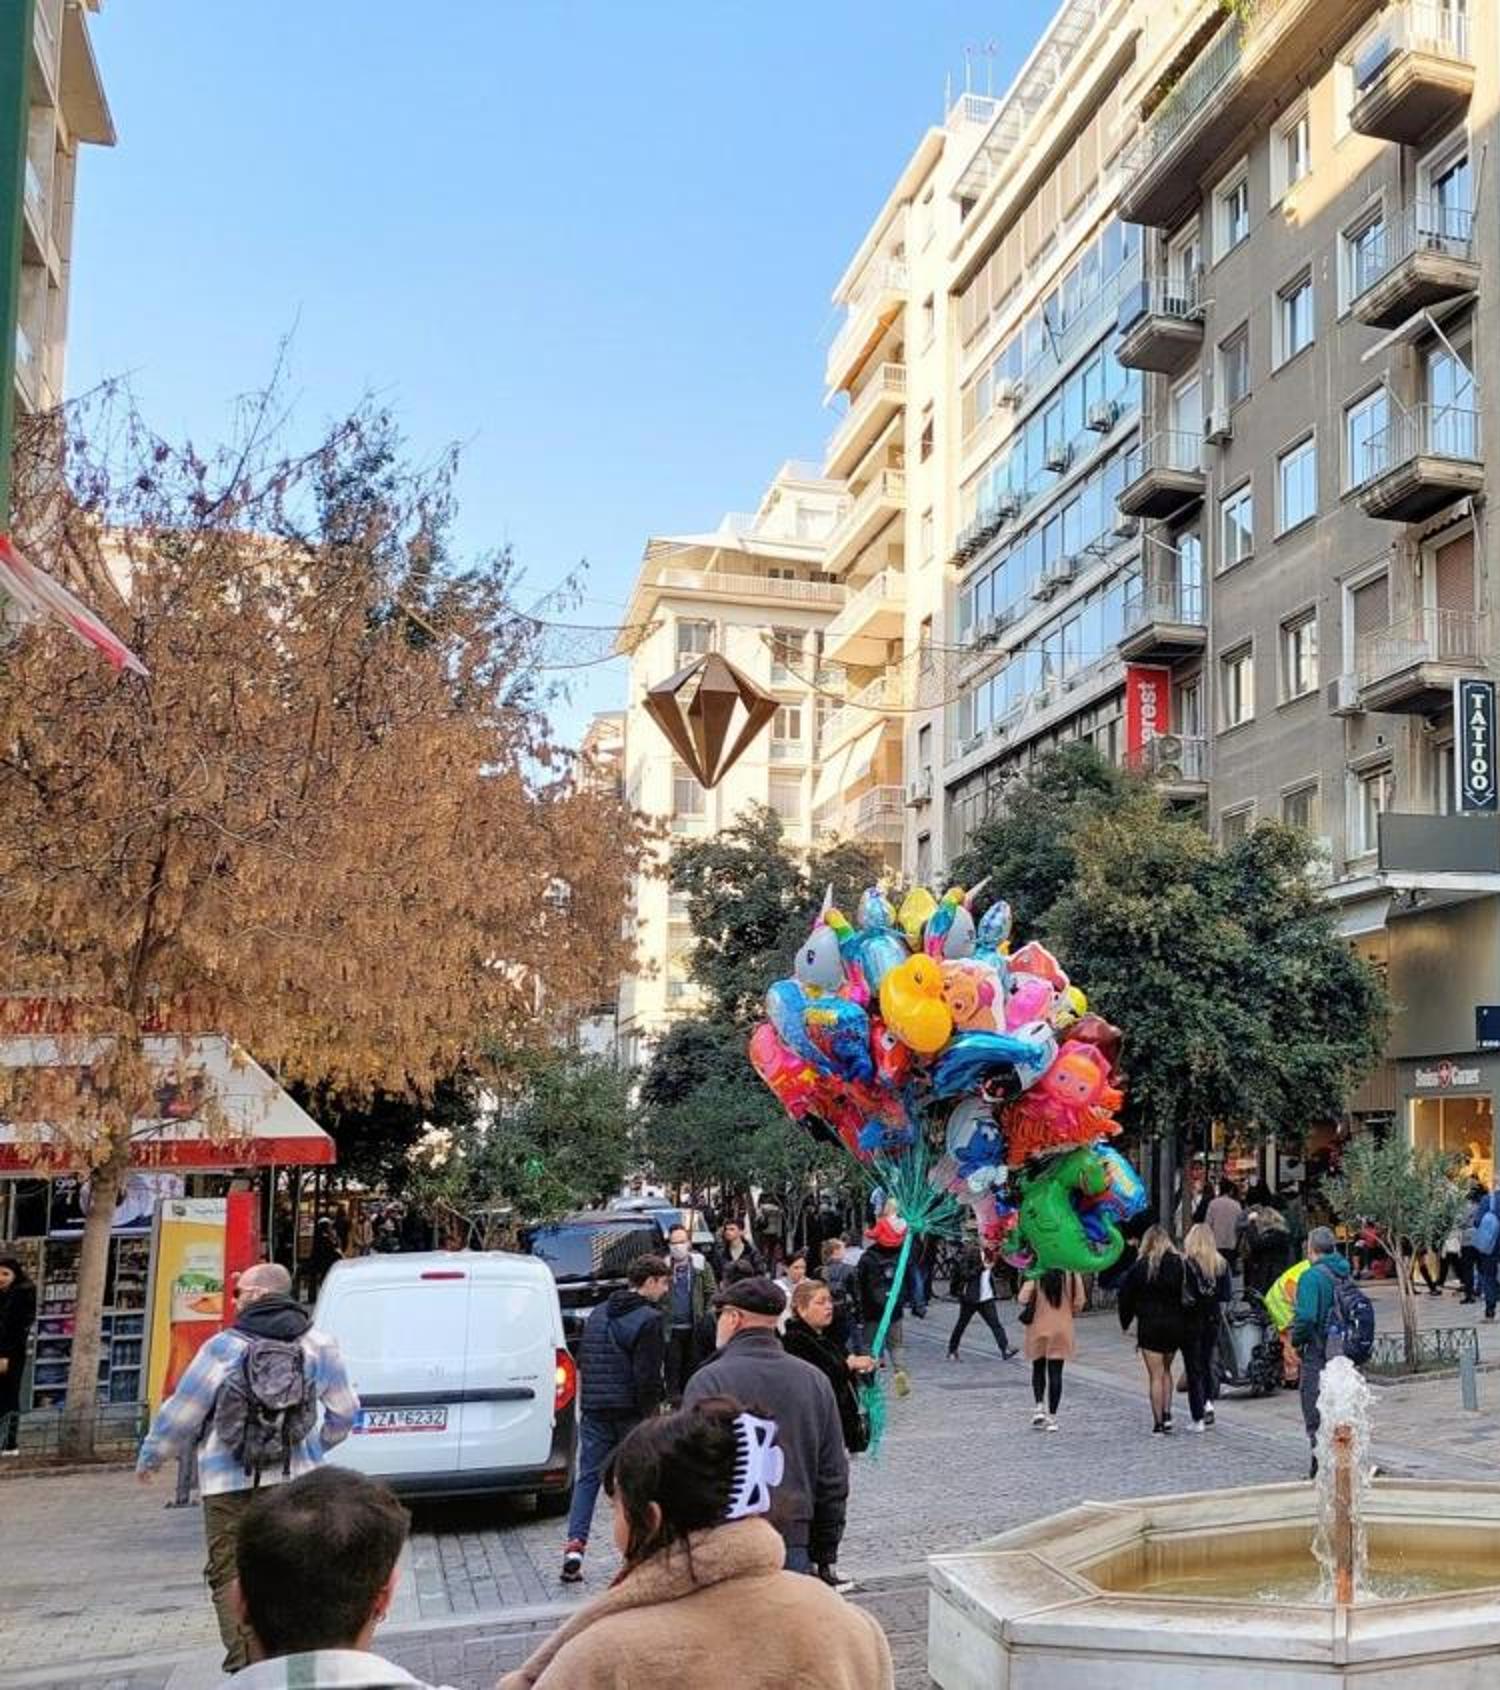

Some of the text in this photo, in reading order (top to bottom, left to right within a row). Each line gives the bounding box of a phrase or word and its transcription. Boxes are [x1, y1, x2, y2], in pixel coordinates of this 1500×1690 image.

[1138, 681, 1157, 746] erest
[1470, 693, 1488, 790] TATTOO
[405, 1410, 445, 1425] 6232
